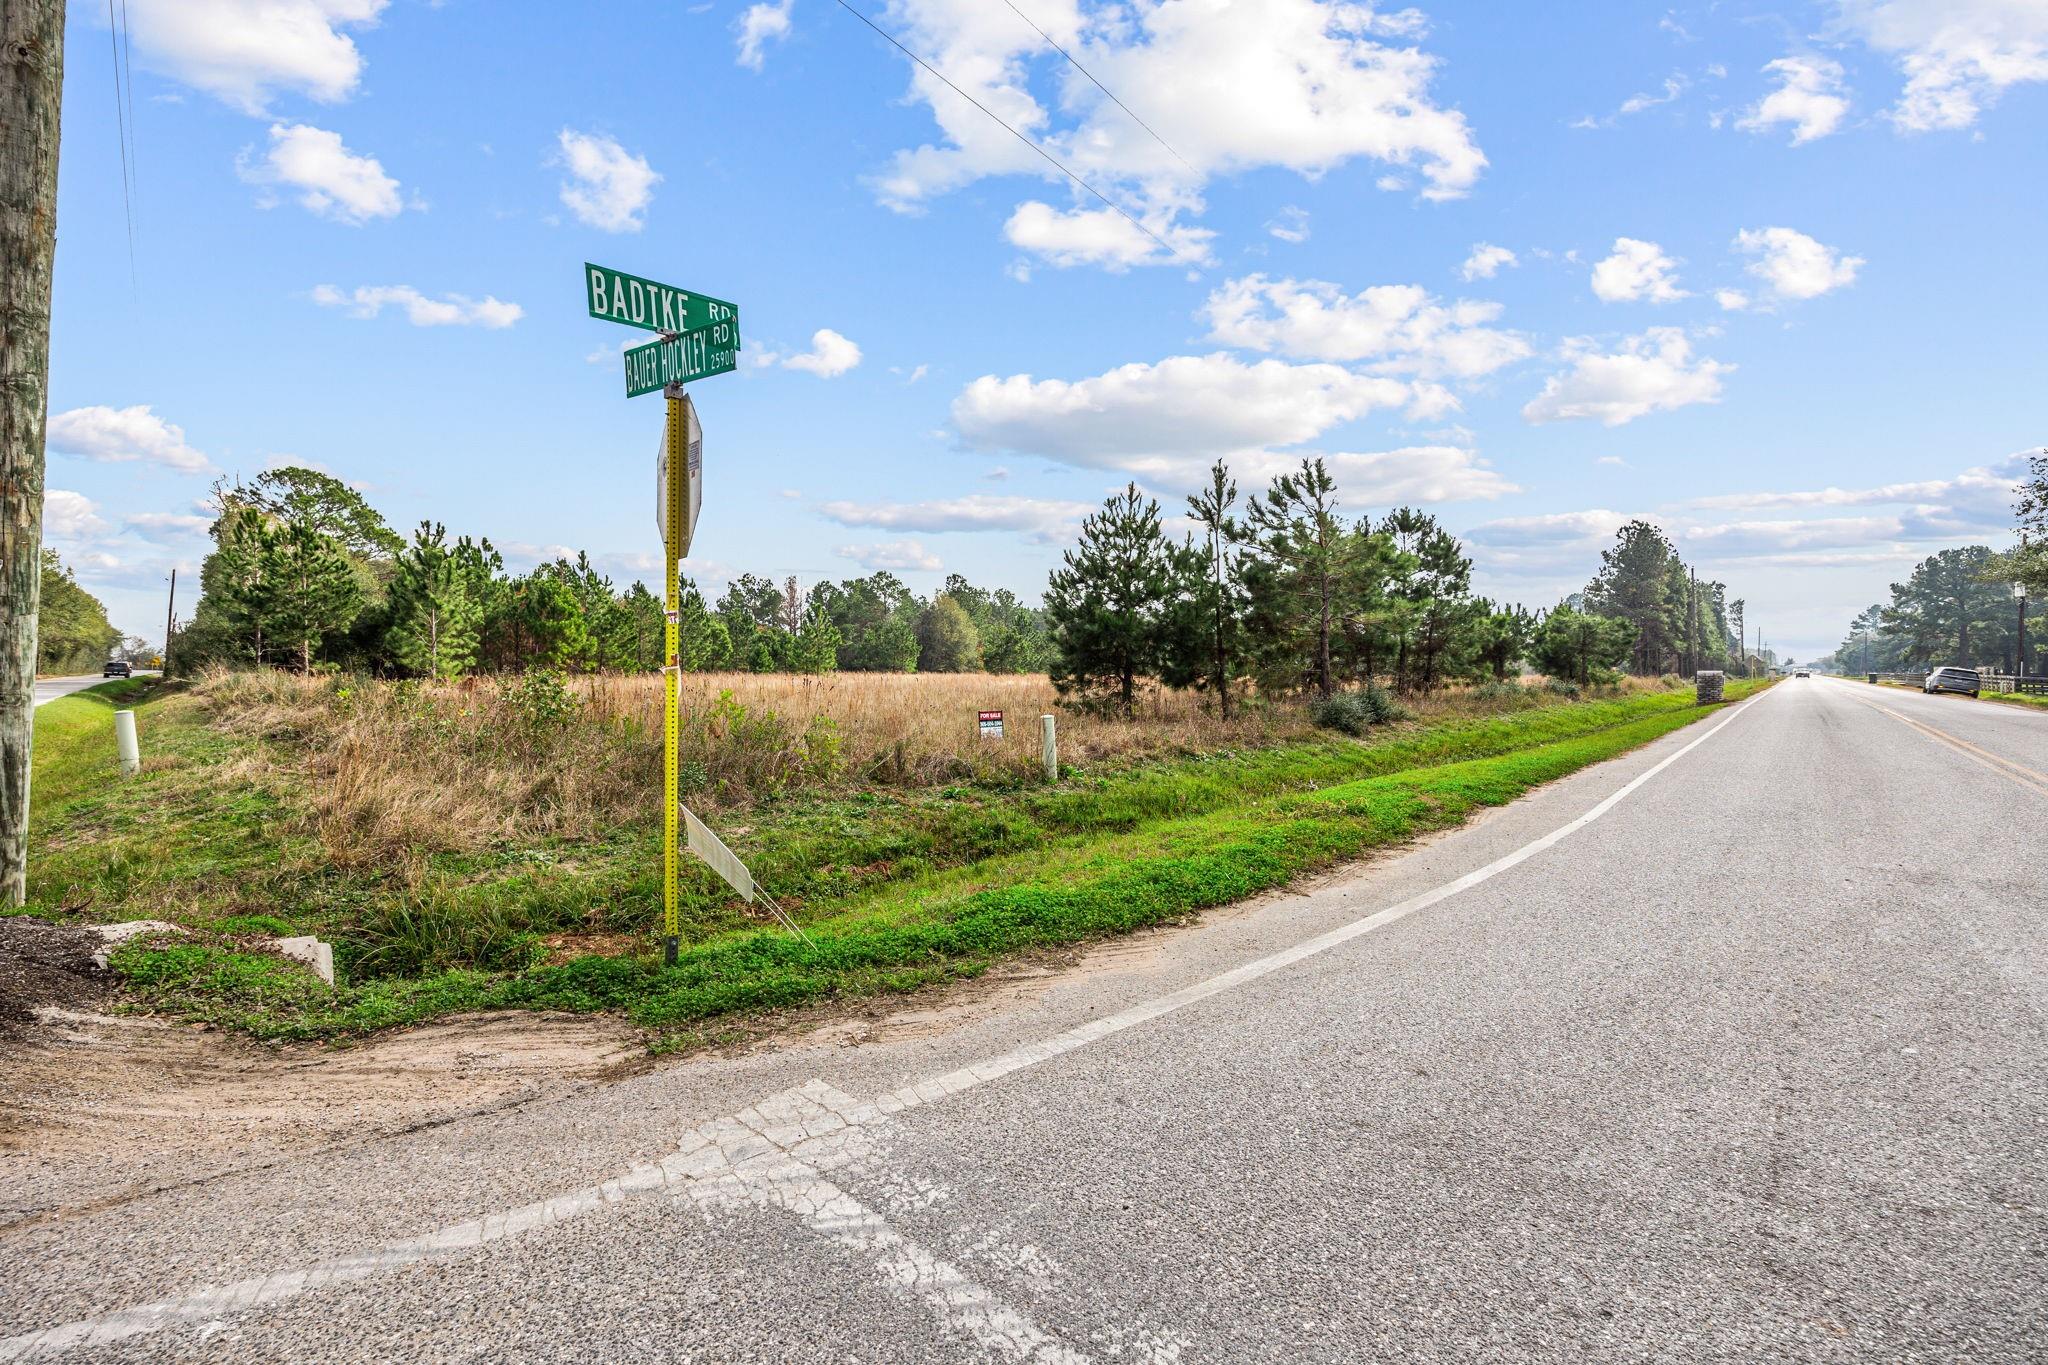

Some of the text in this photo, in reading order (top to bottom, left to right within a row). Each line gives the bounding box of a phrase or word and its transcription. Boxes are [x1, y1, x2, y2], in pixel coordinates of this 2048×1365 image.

[591, 268, 731, 333] BADTKE RD
[626, 323, 729, 392] BAUER HOCKLEY RD
[710, 348, 735, 370] 25900
